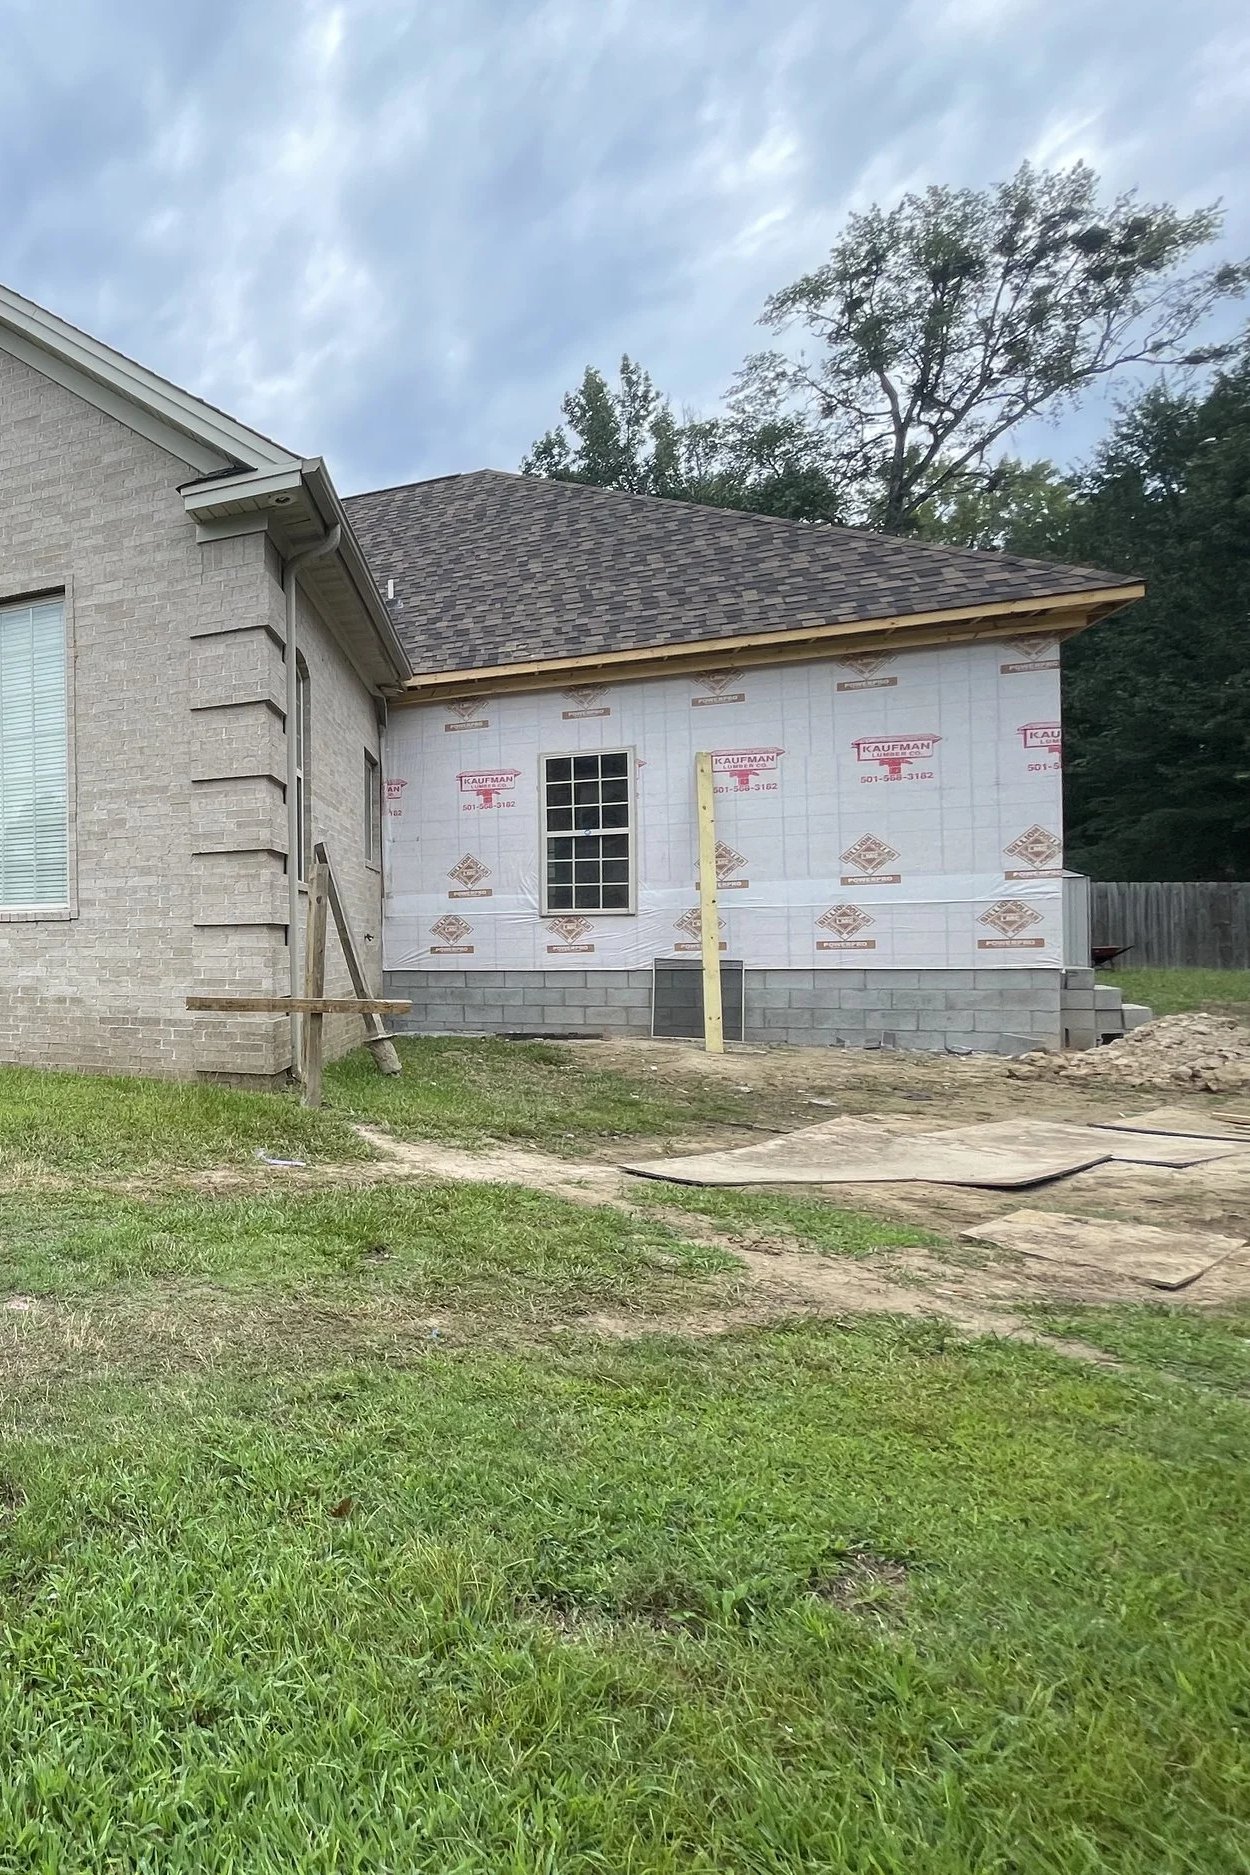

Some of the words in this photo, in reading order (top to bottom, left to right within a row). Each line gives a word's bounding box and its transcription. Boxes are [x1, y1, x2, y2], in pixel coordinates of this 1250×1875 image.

[862, 742, 930, 752] KAUFMAN
[714, 755, 775, 765] KAUFMAN
[464, 776, 513, 785] KAUFMAN
[842, 836, 872, 861] BILLION
[870, 840, 896, 858] DOLLAR
[1007, 826, 1040, 854] BILLION
[721, 846, 745, 865] DOLLAR
[676, 908, 701, 928] BILLIO
[818, 904, 845, 926] BILLIO
[979, 900, 1008, 923] BILLIO
